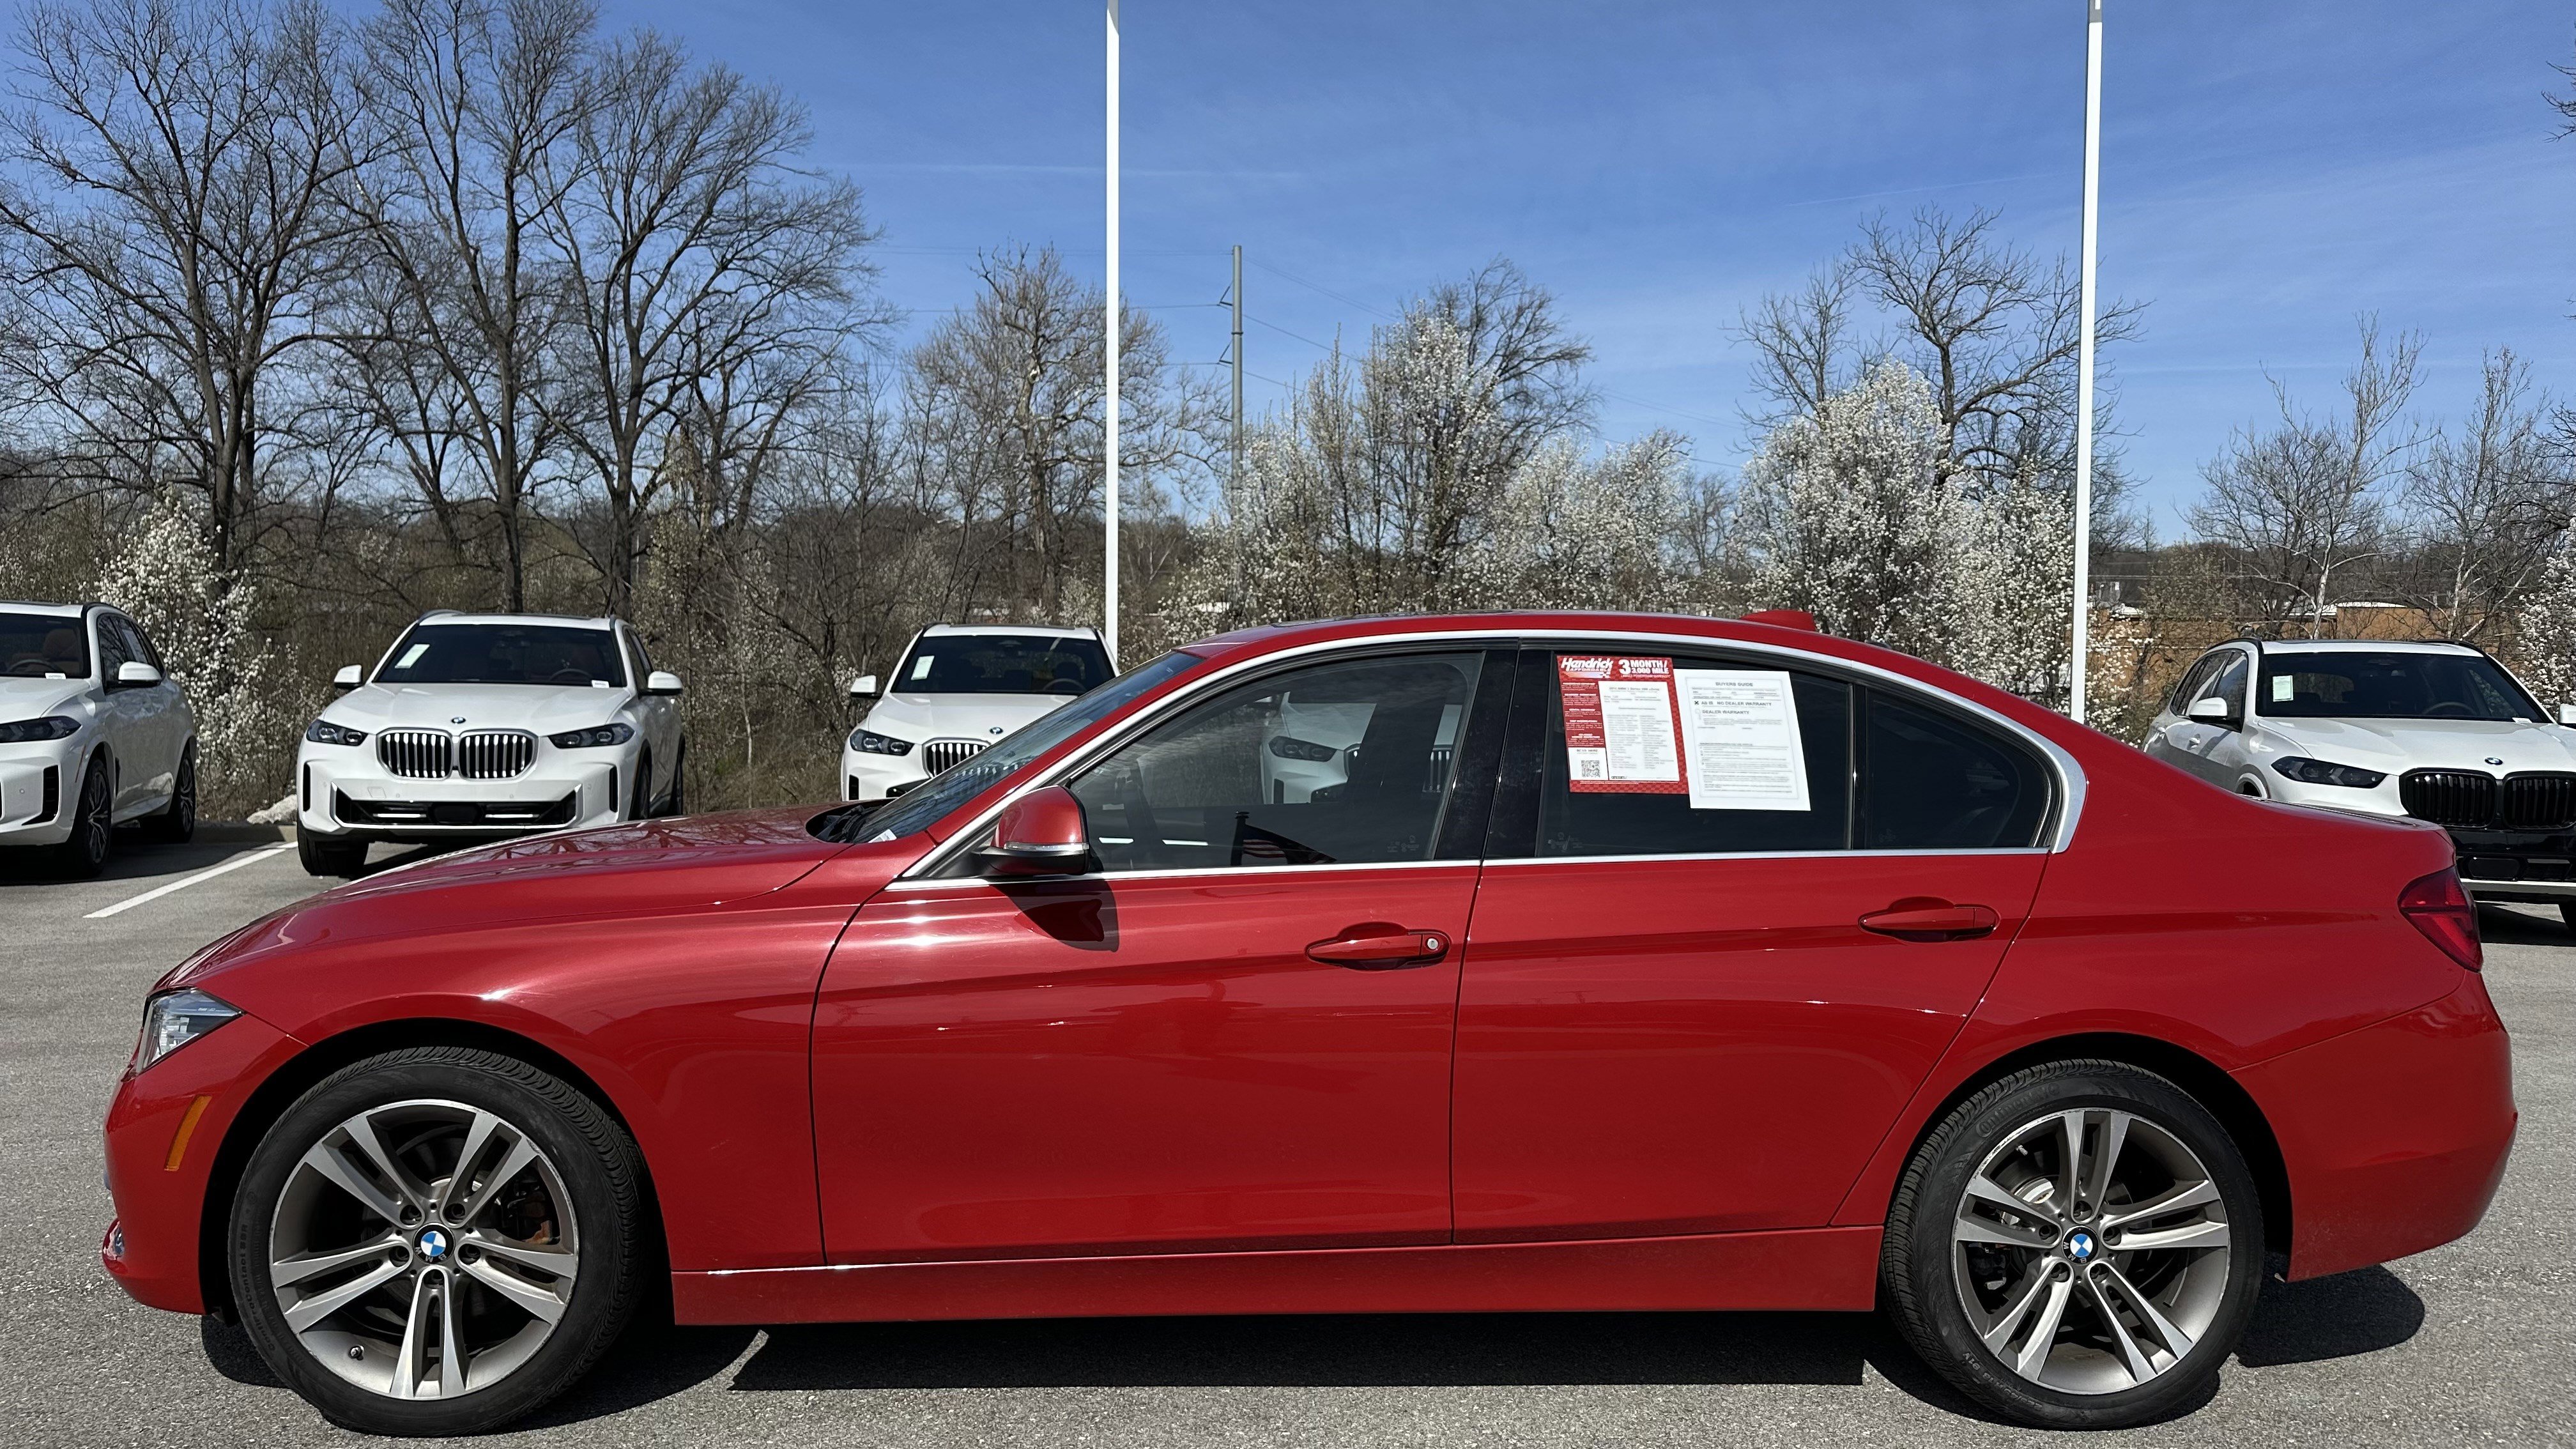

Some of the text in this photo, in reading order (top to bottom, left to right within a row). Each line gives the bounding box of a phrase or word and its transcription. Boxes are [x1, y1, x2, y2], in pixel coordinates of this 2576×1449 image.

[1561, 657, 1614, 671] Hendrick
[1618, 659, 1667, 675] 3 MONTH/
